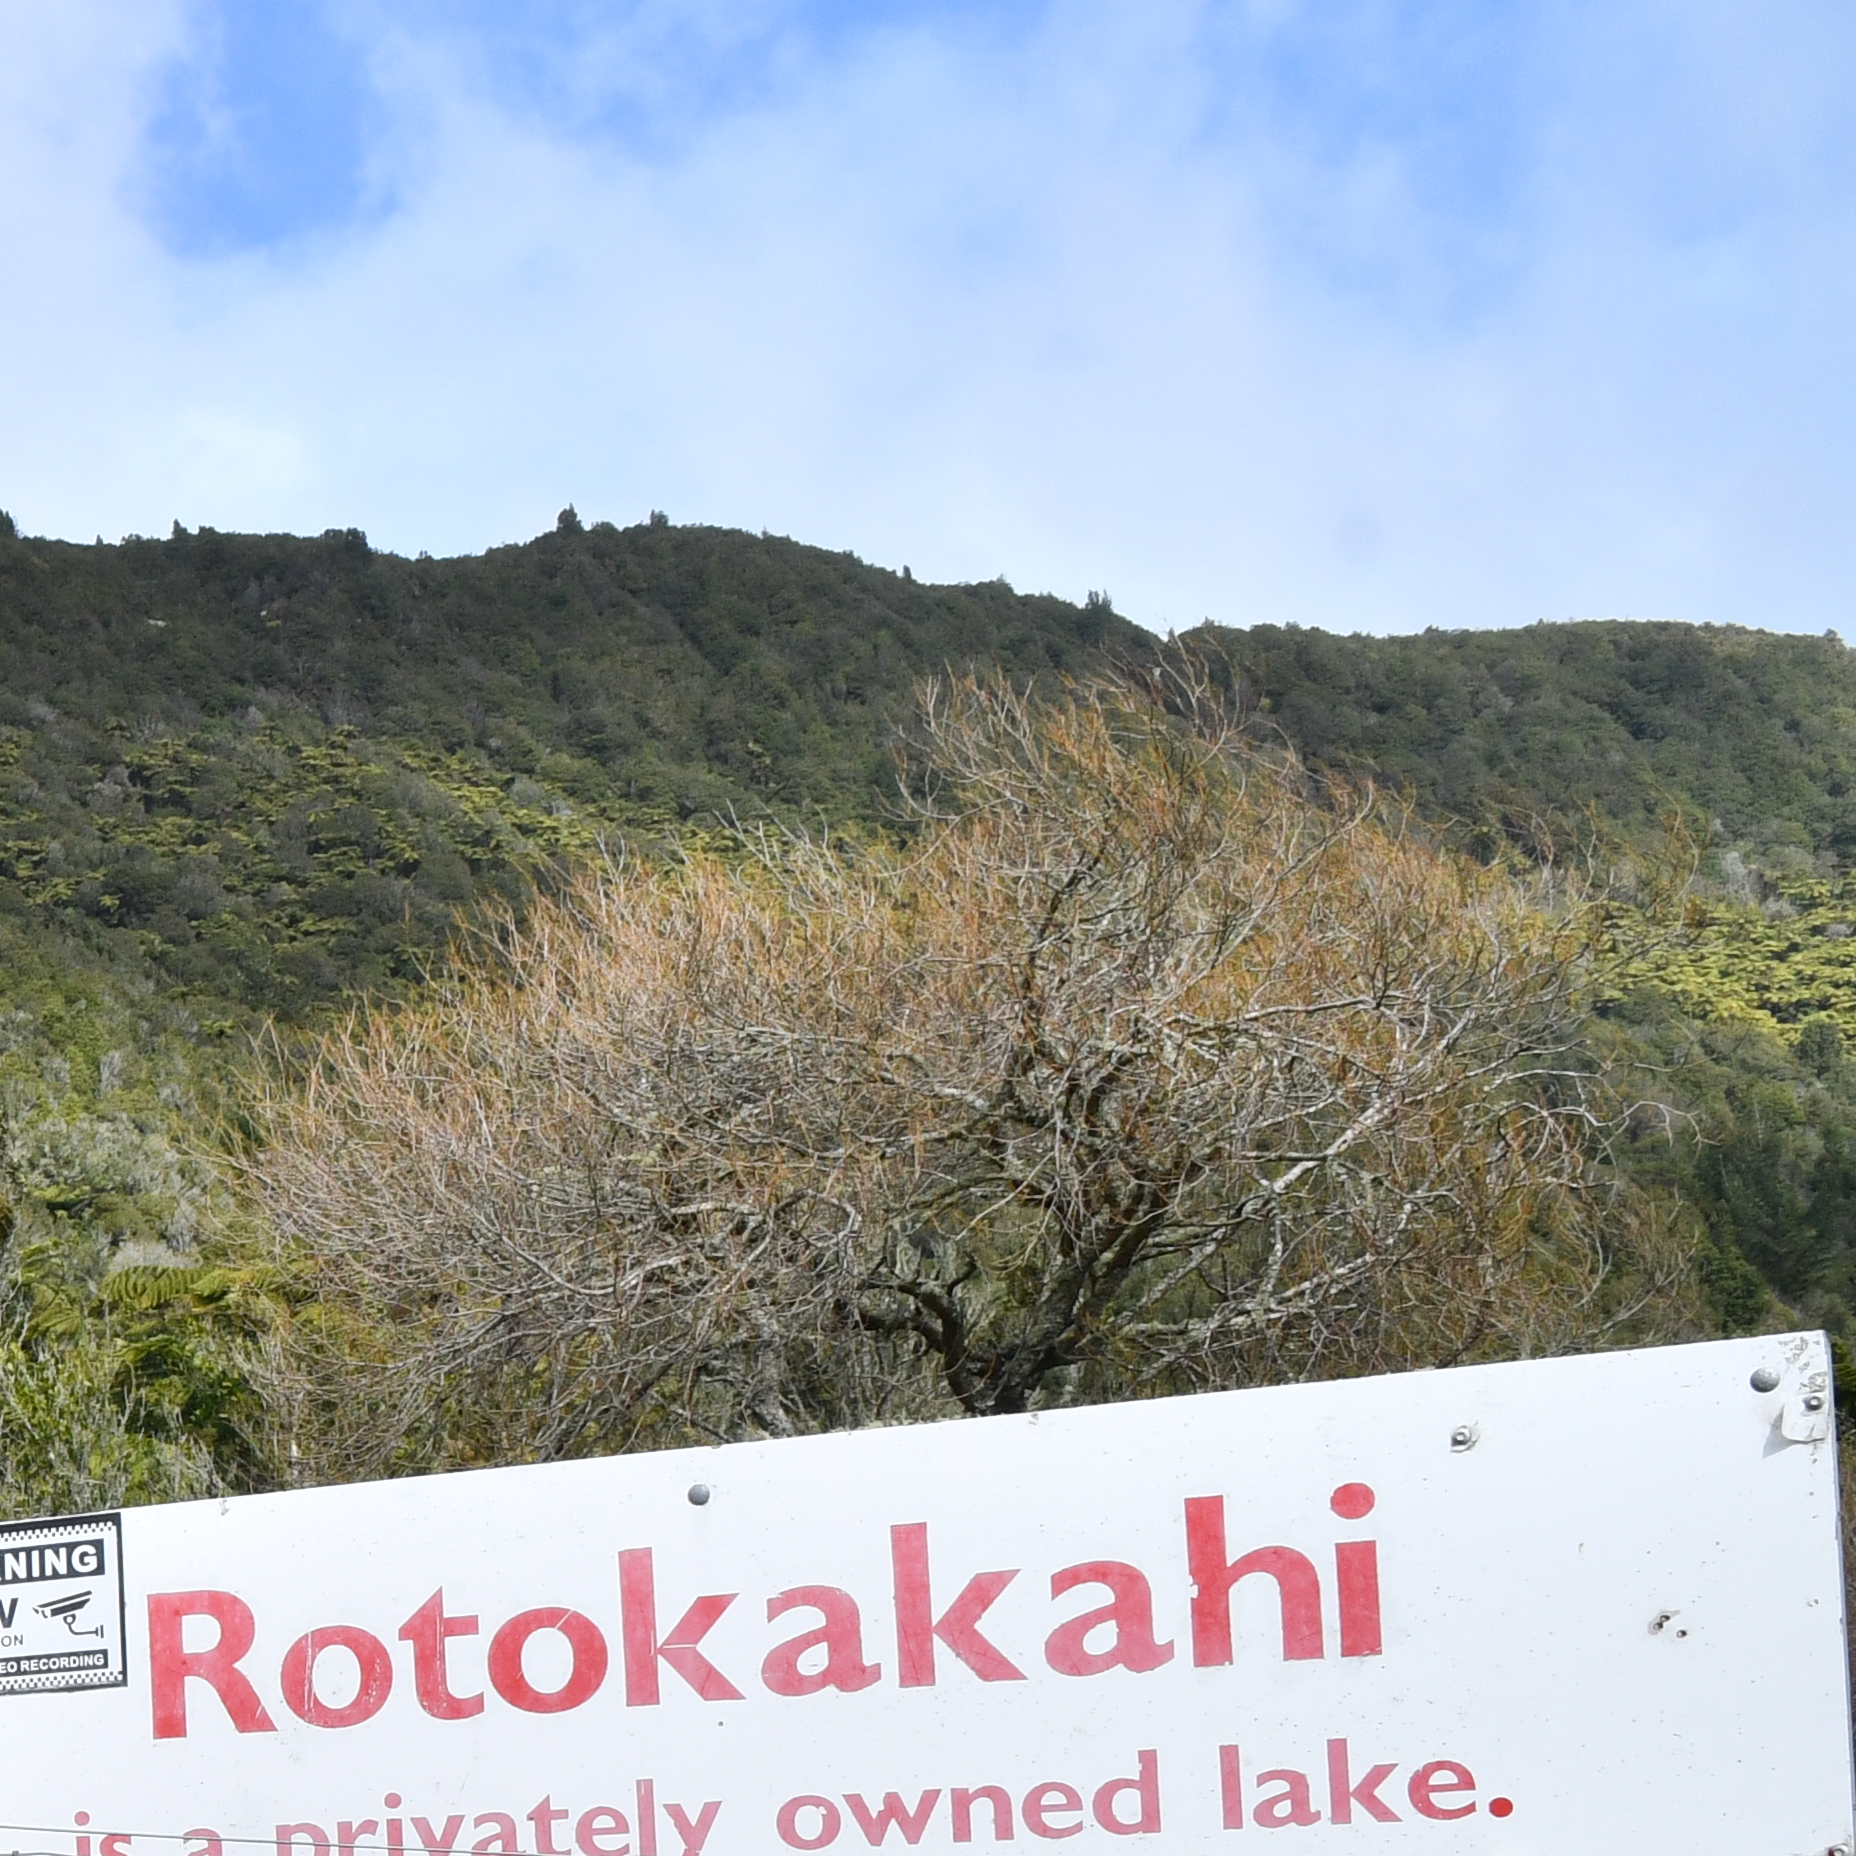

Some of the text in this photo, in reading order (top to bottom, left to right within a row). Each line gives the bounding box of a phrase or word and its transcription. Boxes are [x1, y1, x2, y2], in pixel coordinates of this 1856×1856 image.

[20, 1653, 105, 1672] RECORDING
[146, 1481, 1384, 1741] Rotokakahi
[776, 1749, 1162, 1851] owned
[1219, 1738, 1516, 1831] lake.
